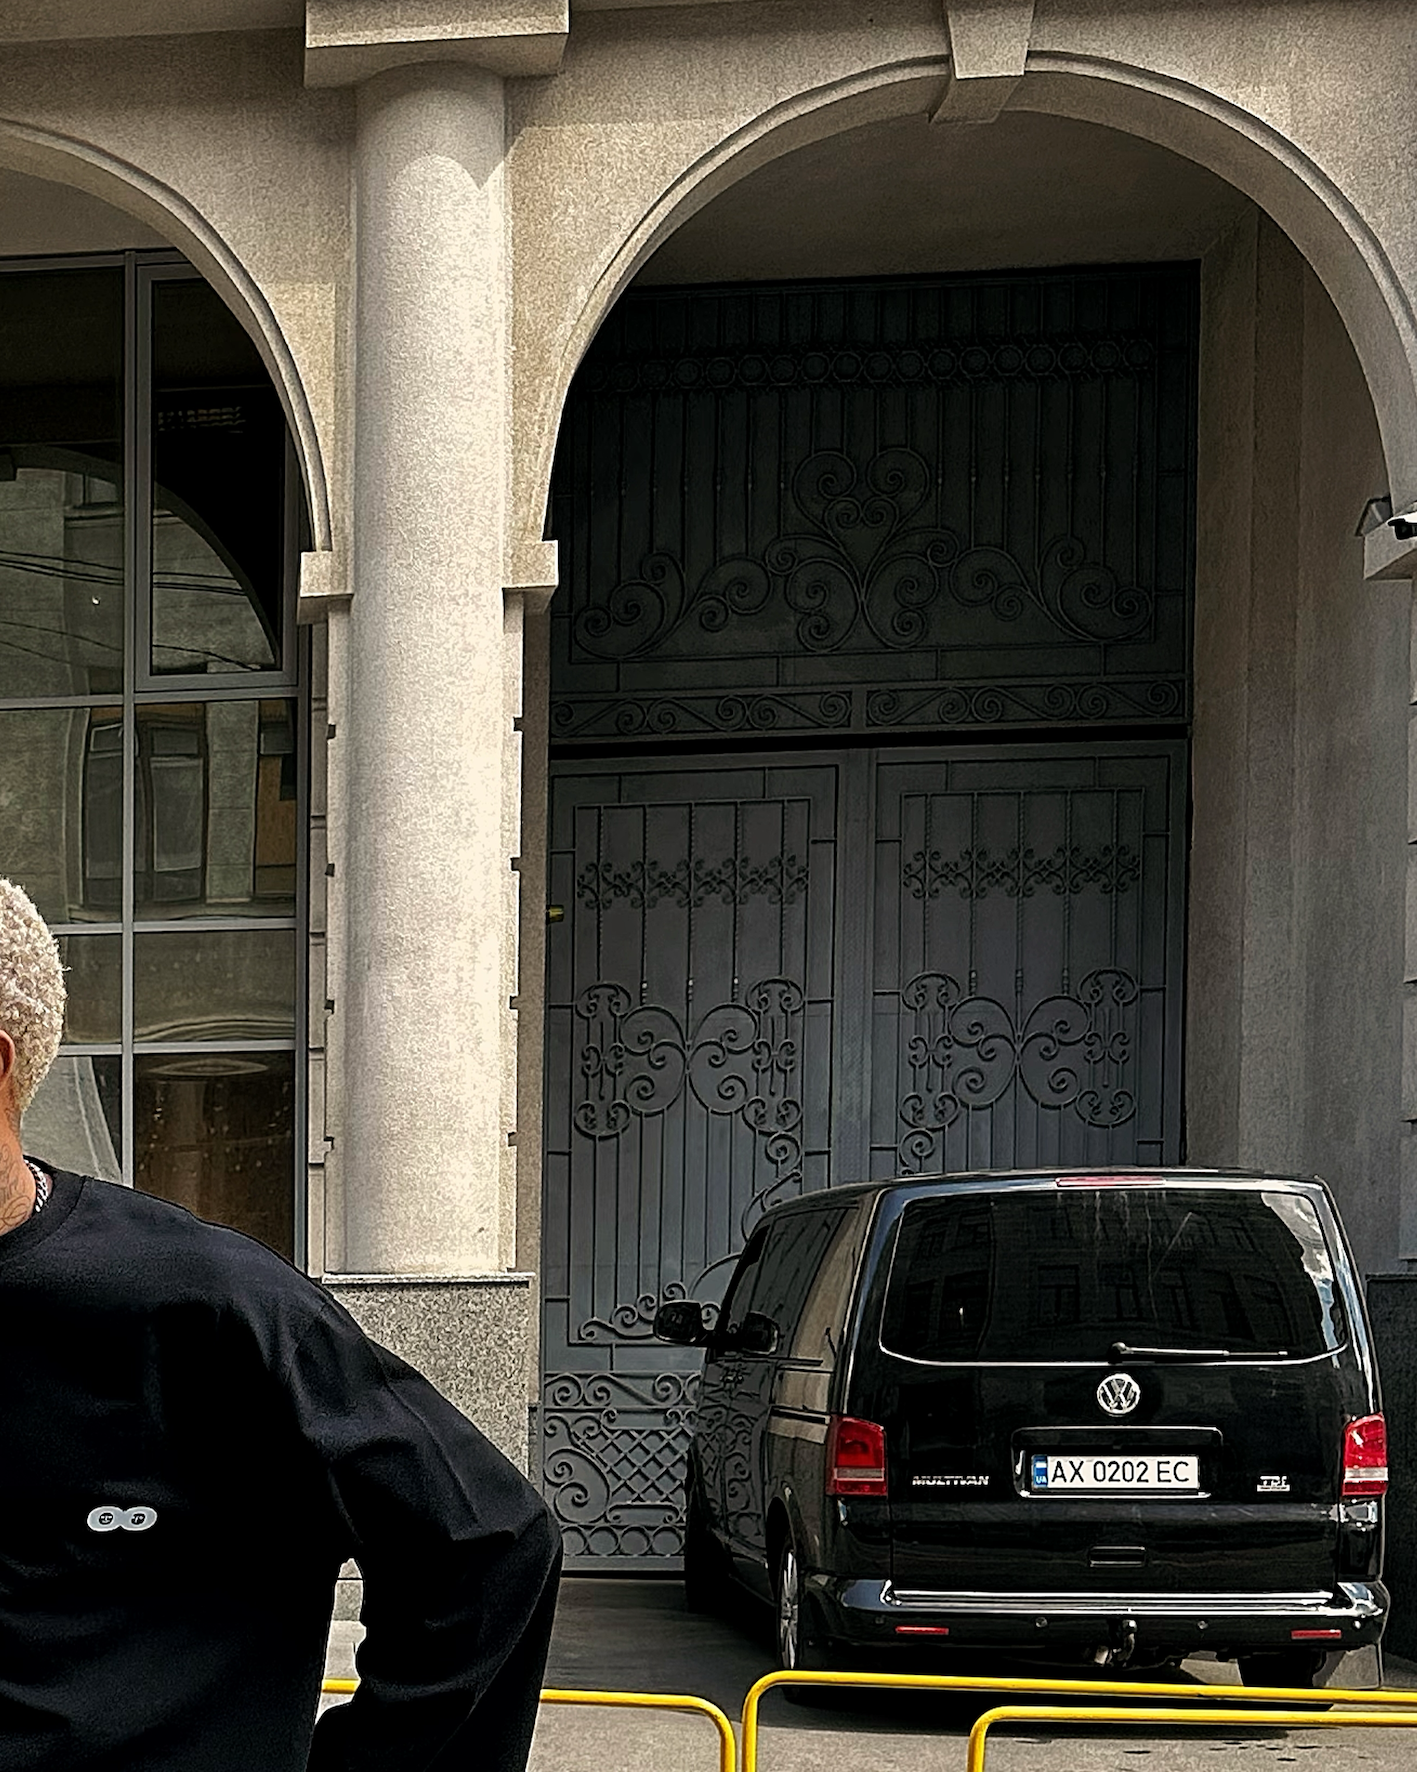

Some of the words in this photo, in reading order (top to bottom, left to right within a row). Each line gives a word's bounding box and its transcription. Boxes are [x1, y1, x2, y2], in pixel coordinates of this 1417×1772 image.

[1051, 1460, 1084, 1483] AX
[1093, 1460, 1149, 1483] 0202
[1157, 1460, 1190, 1483] EC
[912, 1475, 990, 1486] MULTIVAN
[1035, 1475, 1047, 1484] UA
